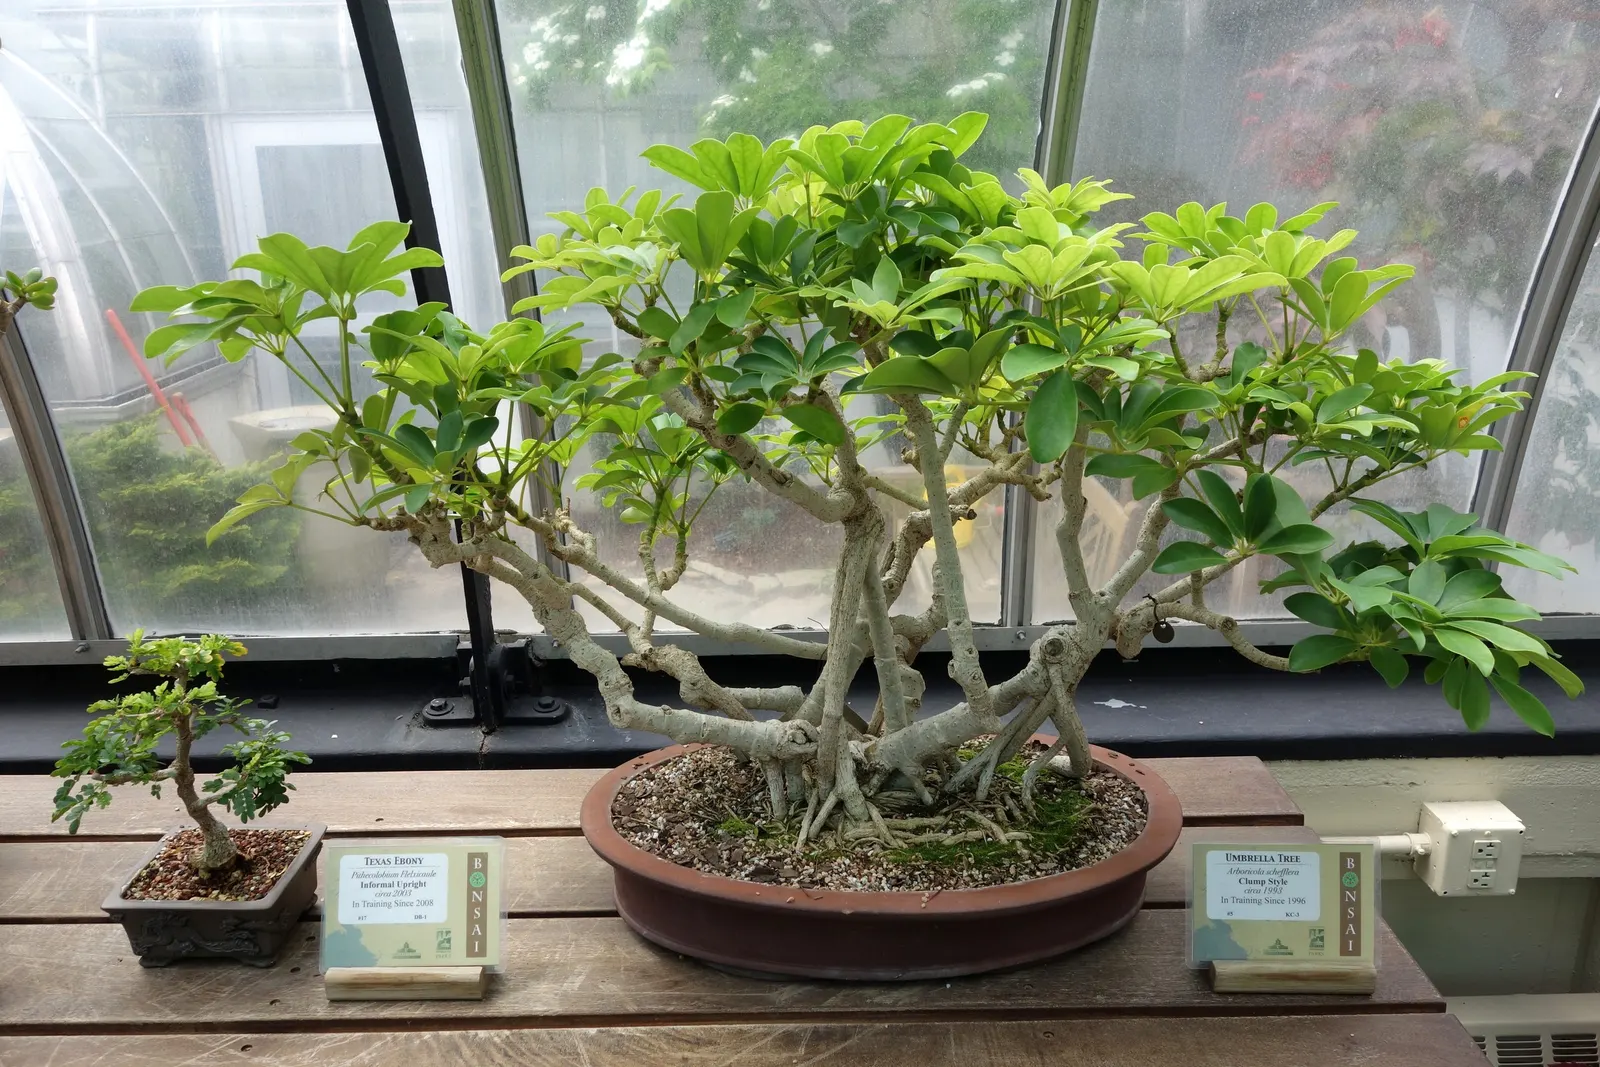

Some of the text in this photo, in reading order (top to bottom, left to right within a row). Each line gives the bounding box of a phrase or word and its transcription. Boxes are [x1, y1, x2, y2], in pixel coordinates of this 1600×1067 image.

[364, 856, 424, 865] TEXAS EBONY
[1225, 853, 1301, 862] UMBRELLA TREE
[1265, 868, 1299, 877] schefflera
[397, 880, 426, 889] Upright
[1238, 878, 1288, 887] Clump Style
[361, 900, 392, 909] Training
[1231, 896, 1262, 906] Training
